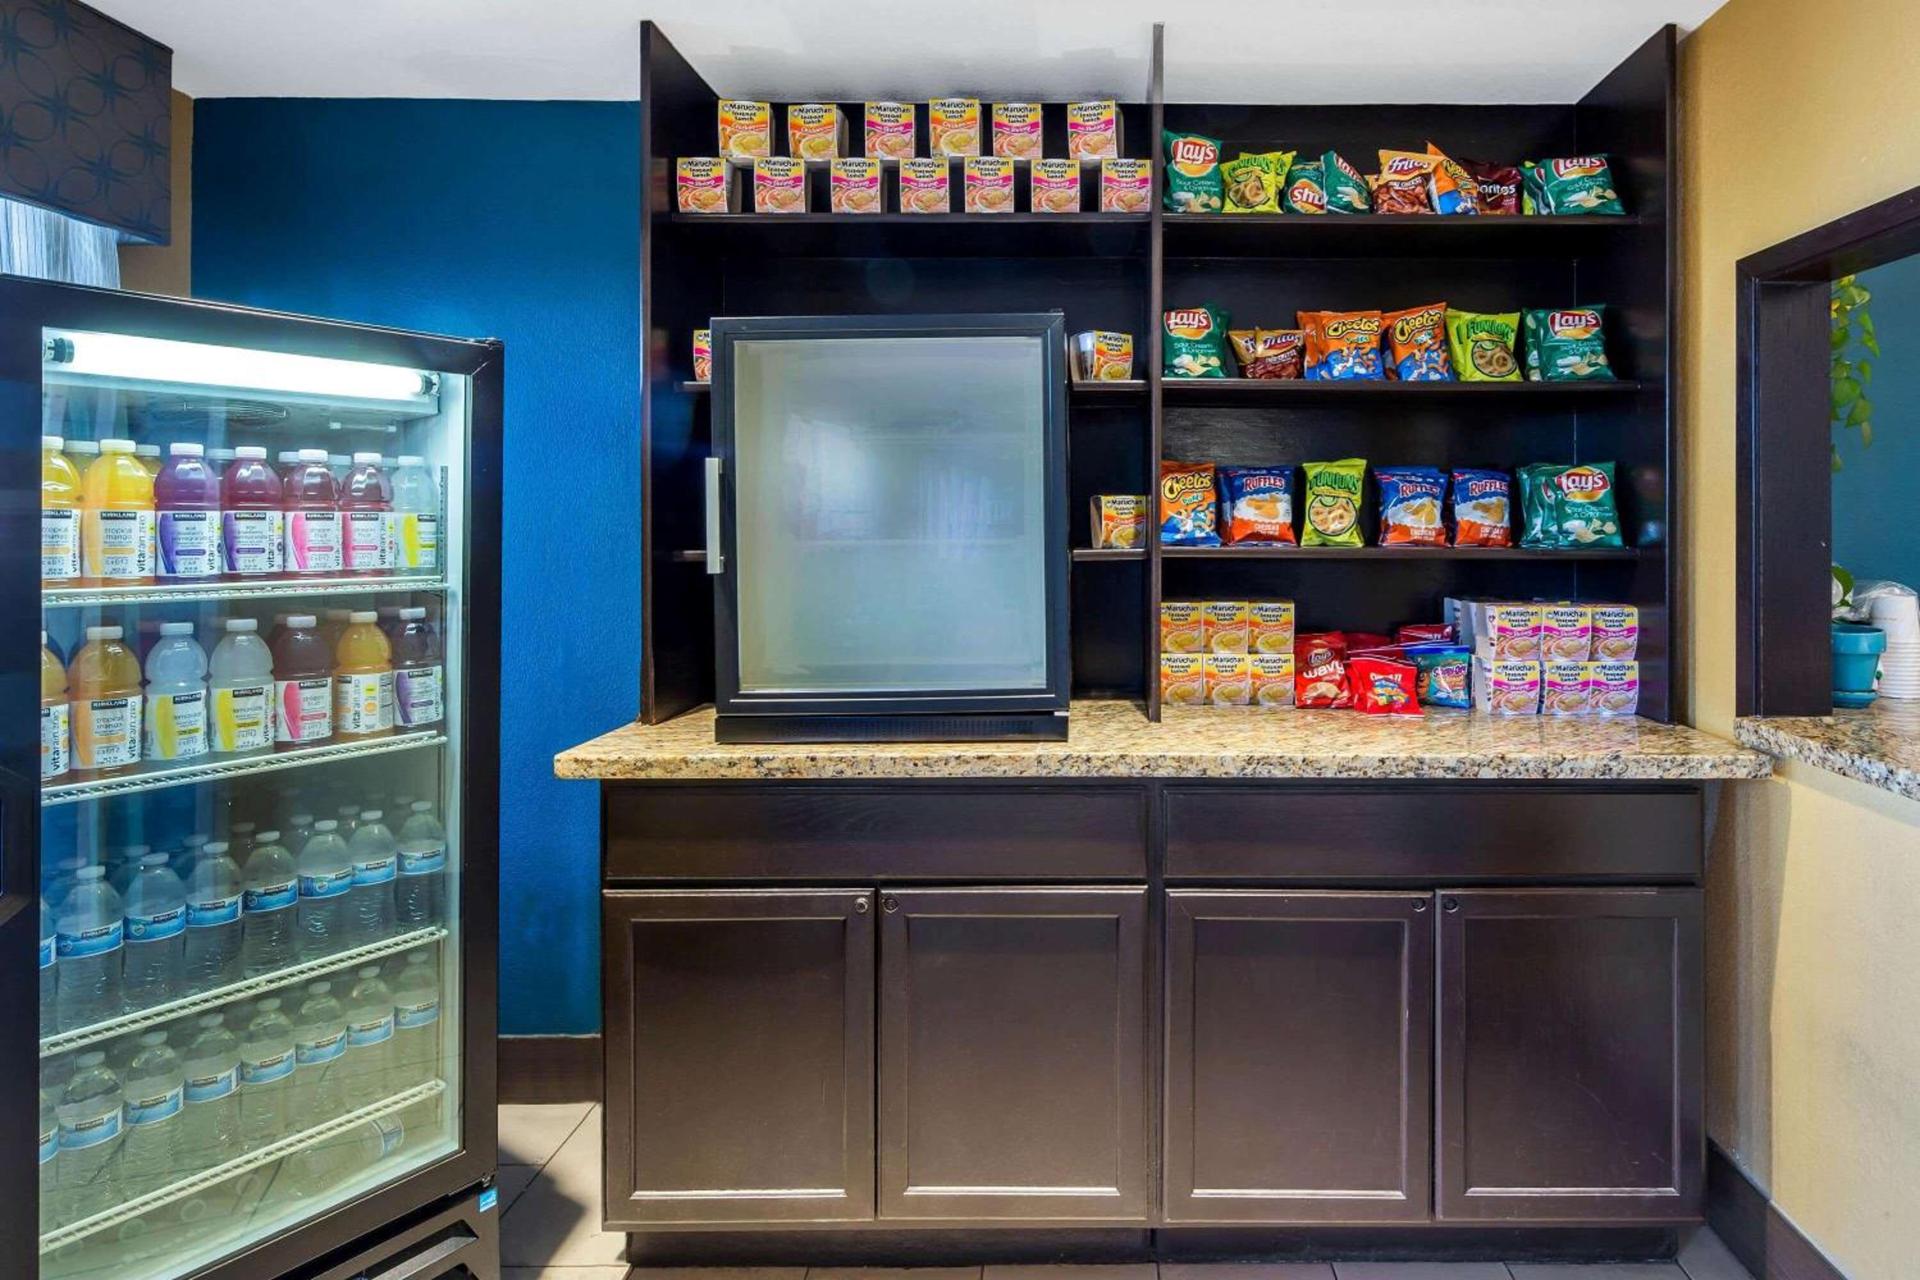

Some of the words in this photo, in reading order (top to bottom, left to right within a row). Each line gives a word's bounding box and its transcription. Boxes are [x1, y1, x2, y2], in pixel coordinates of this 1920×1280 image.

[729, 104, 765, 112] Maruchan
[1077, 104, 1111, 112] Maruchan
[1176, 139, 1216, 164] Lay's
[1478, 184, 1516, 194] oritos
[1164, 474, 1212, 498] Cheetos
[1244, 476, 1285, 492] RUFFLES
